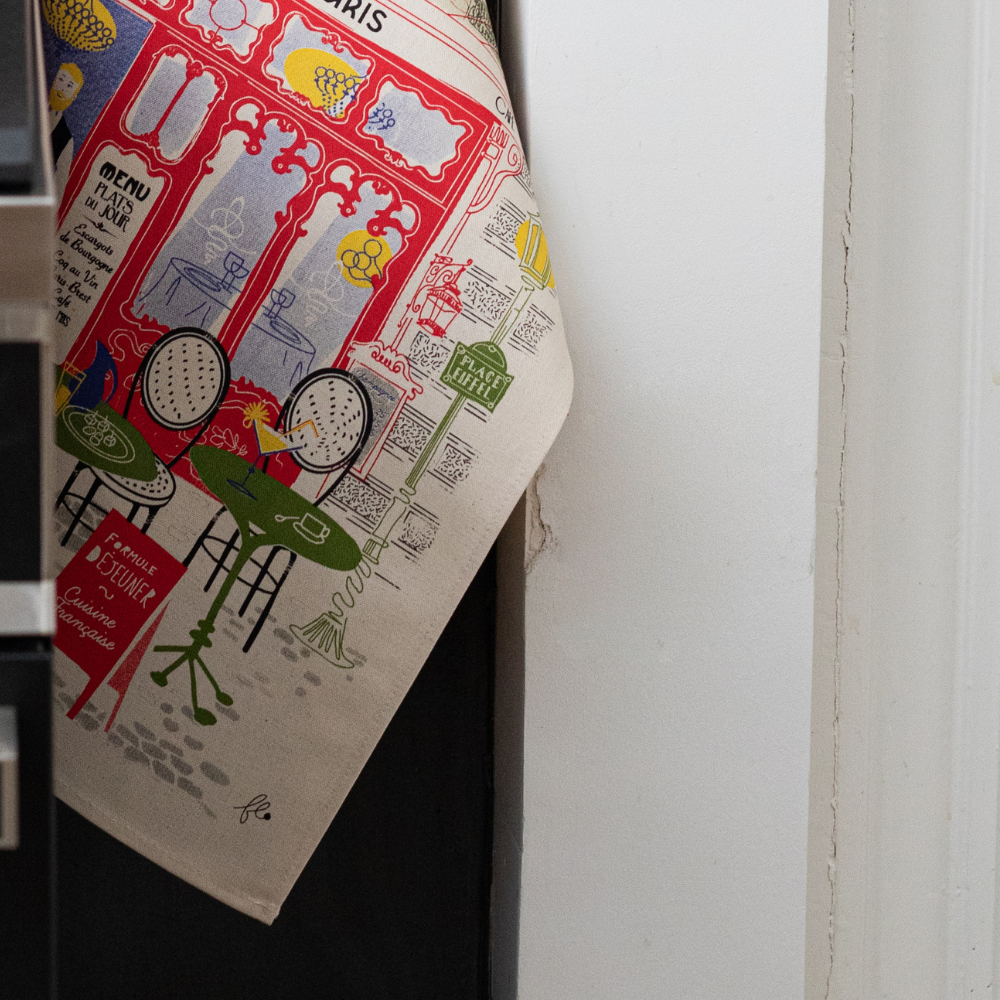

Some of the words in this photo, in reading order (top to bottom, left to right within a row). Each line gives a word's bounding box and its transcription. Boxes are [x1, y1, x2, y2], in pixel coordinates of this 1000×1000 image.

[94, 182, 134, 215] PLATS
[99, 161, 151, 202] MENU
[85, 196, 97, 210] DU
[99, 204, 131, 232] JOUR
[60, 230, 71, 244] de
[70, 234, 113, 274] Bourgogne
[73, 223, 114, 255] Escargots
[70, 266, 80, 277] au
[84, 270, 99, 290] Vin
[453, 368, 491, 400] EIFFEL
[460, 354, 506, 389] PLACE
[105, 532, 157, 576] FORMULE
[85, 545, 156, 609] DÉJEUNER
[64, 586, 116, 629] Cuisine
